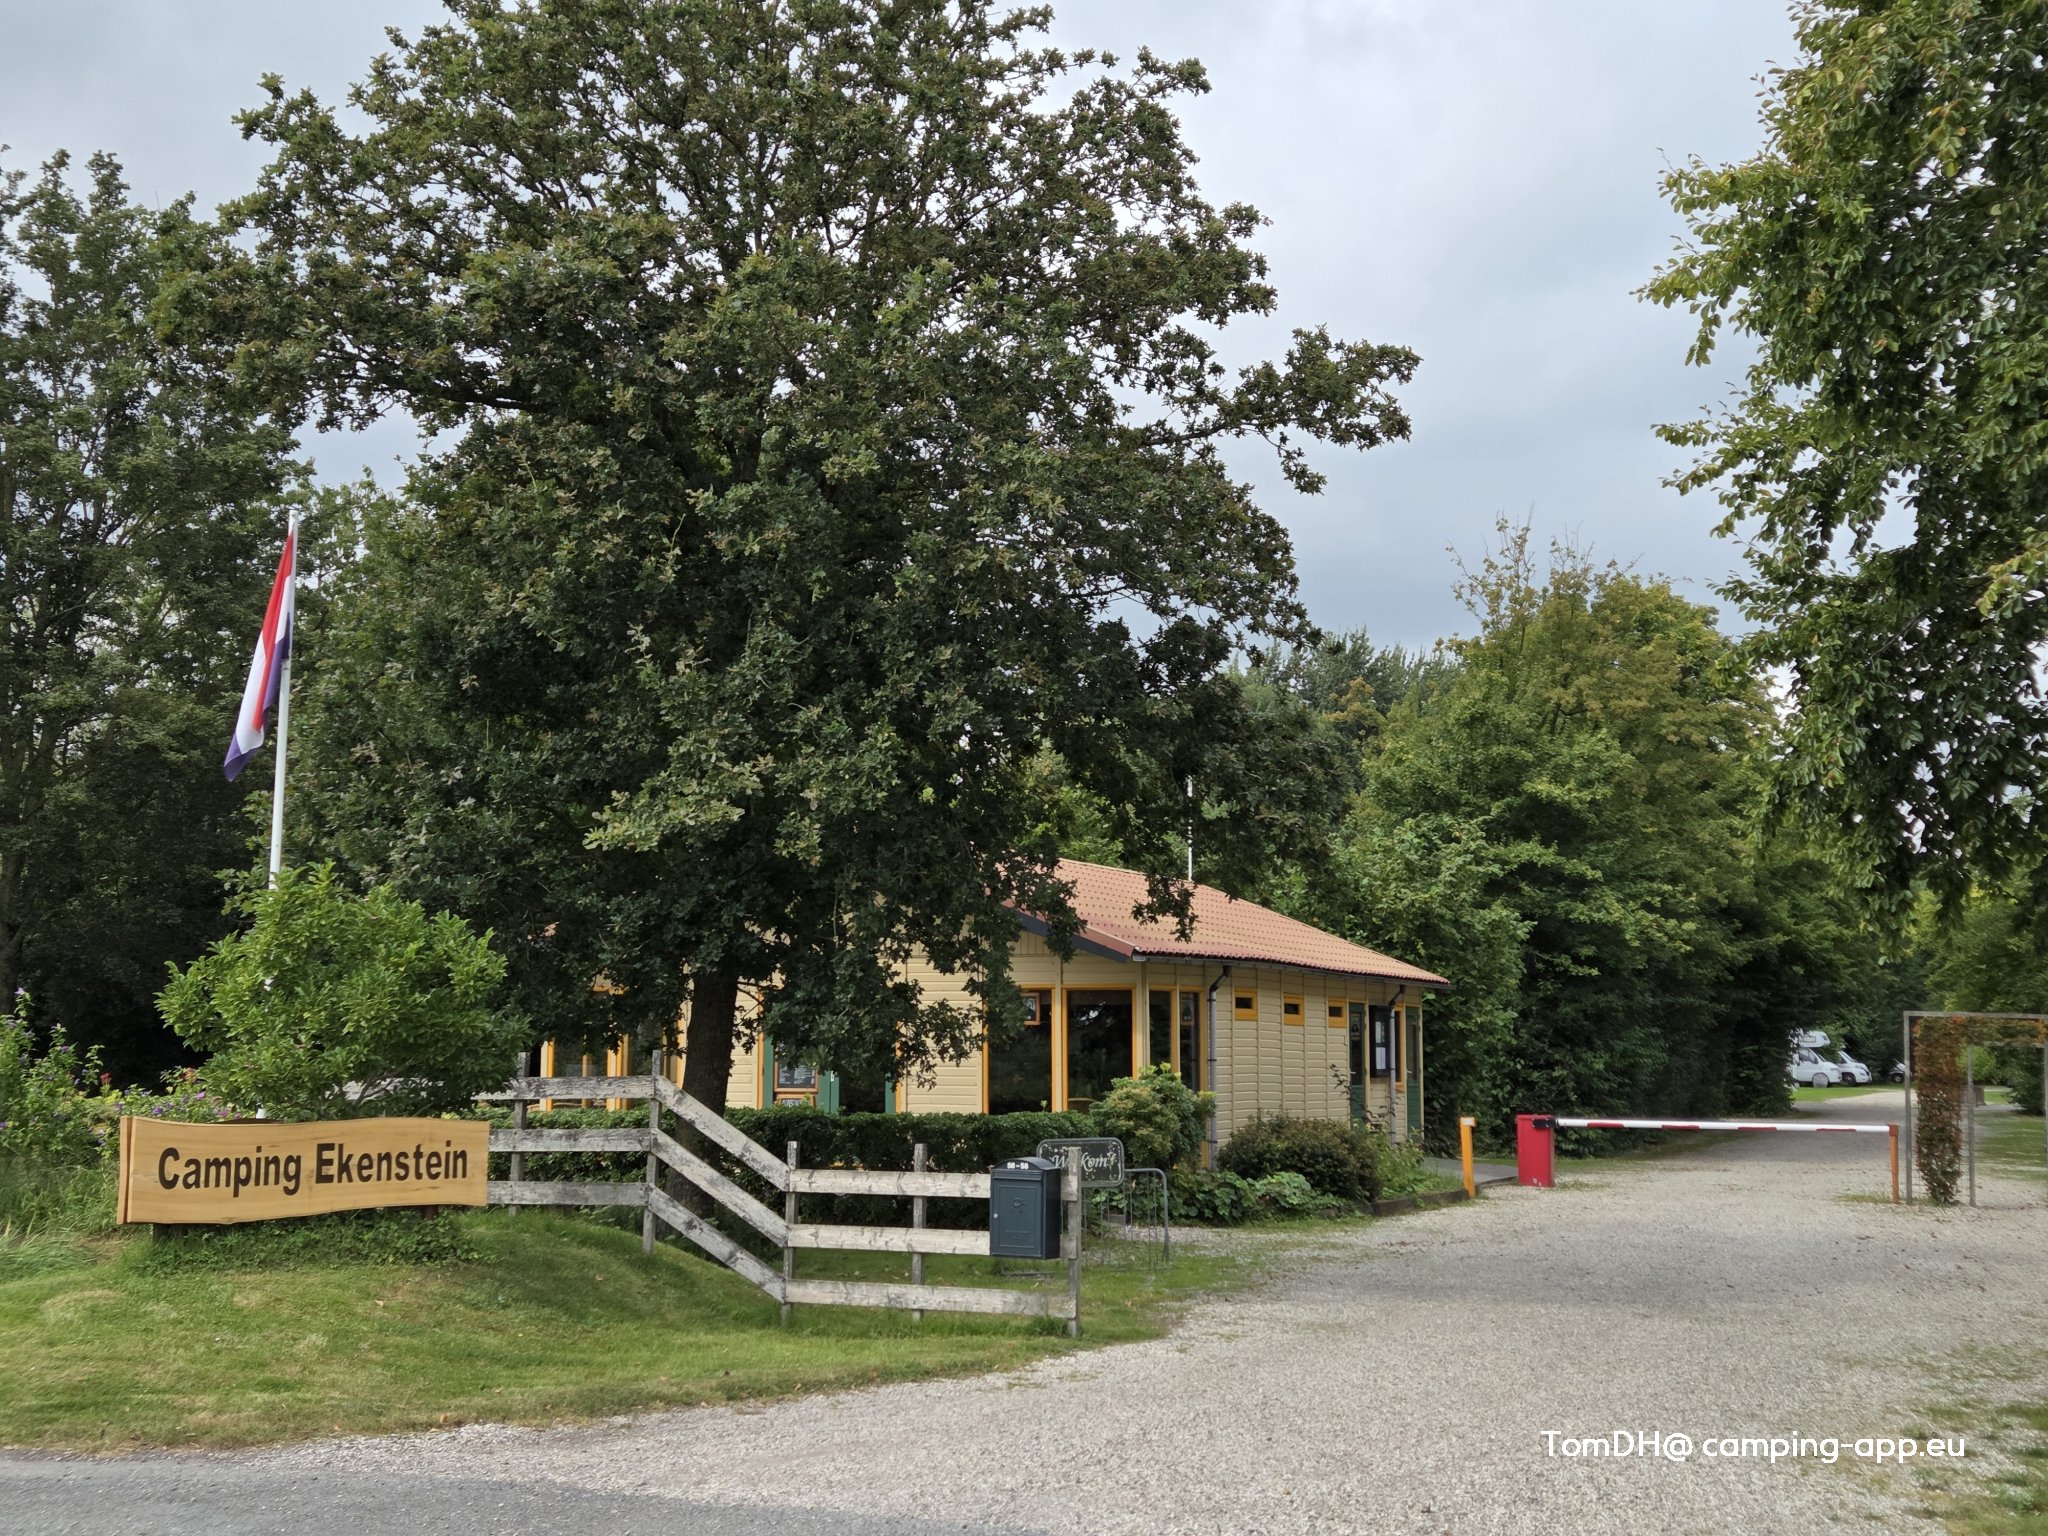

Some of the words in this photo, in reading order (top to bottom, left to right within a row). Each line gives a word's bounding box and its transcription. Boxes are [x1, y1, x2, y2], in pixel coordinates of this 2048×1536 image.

[158, 1145, 301, 1197] Camping
[315, 1140, 468, 1184] Ekenstein
[1049, 1152, 1109, 1172] Wkom
